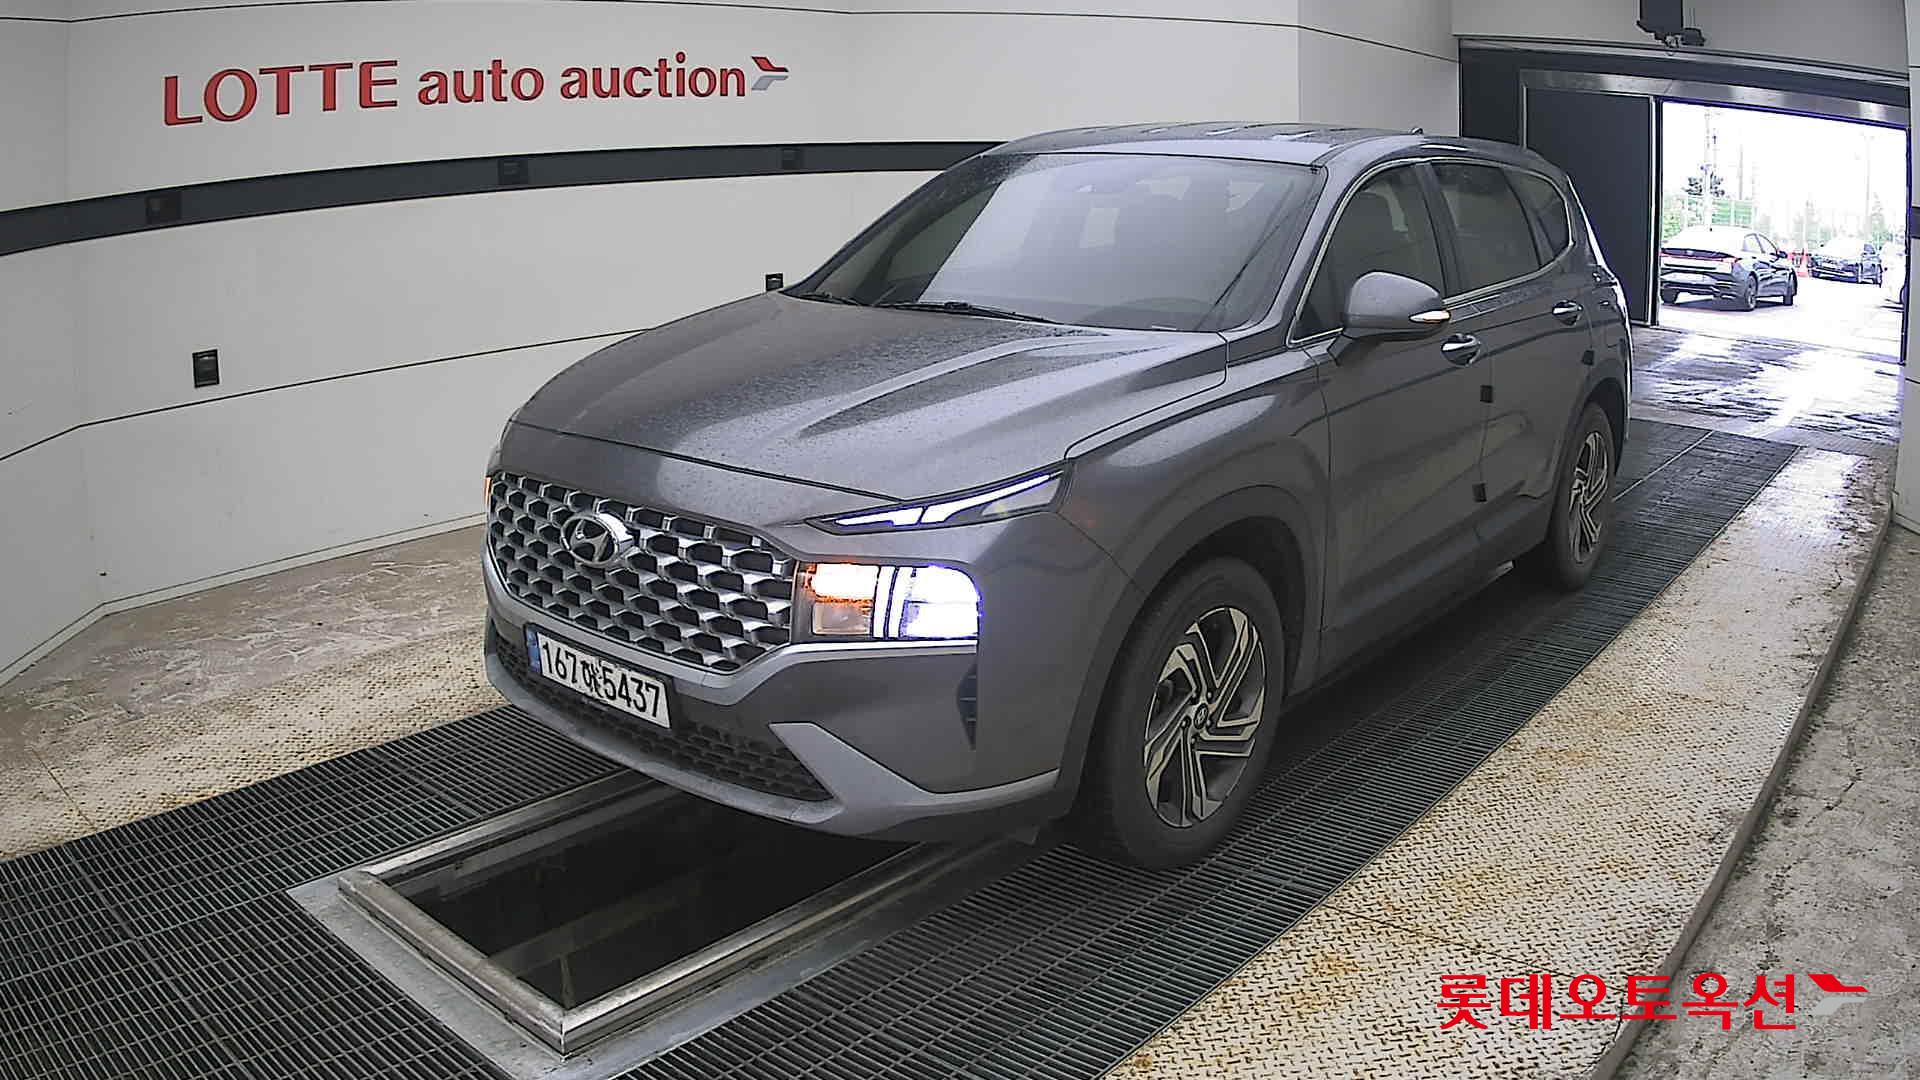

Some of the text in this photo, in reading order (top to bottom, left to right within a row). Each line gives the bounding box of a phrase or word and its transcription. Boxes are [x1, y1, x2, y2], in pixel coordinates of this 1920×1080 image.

[164, 52, 746, 126] LOTTE auto auction
